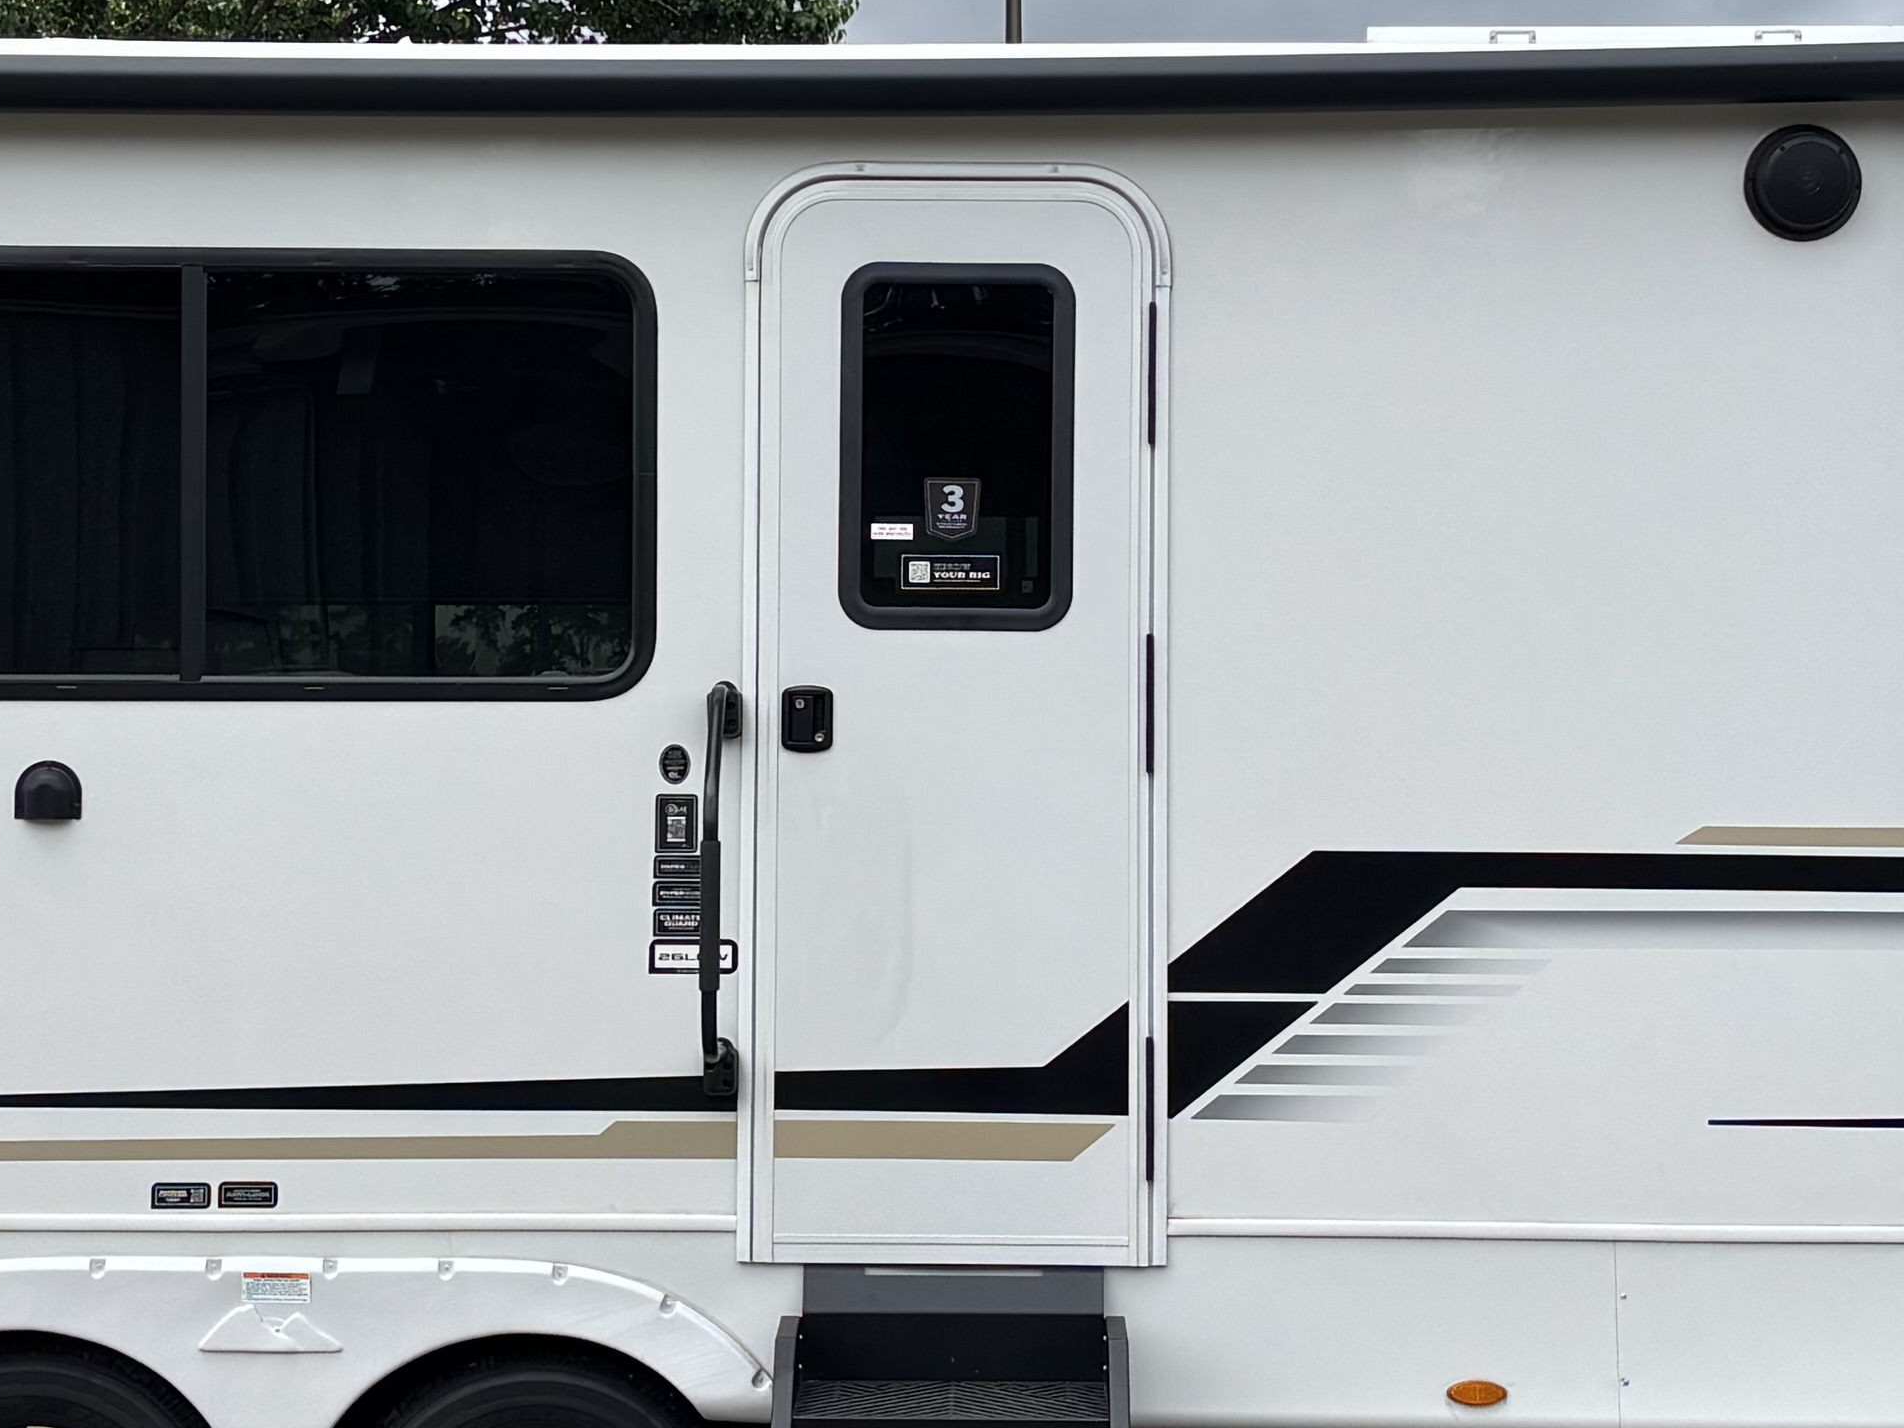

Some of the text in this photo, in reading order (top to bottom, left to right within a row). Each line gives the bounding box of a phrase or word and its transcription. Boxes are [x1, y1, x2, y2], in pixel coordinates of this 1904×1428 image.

[941, 485, 964, 513] 3
[933, 571, 991, 579] YOUR RIG
